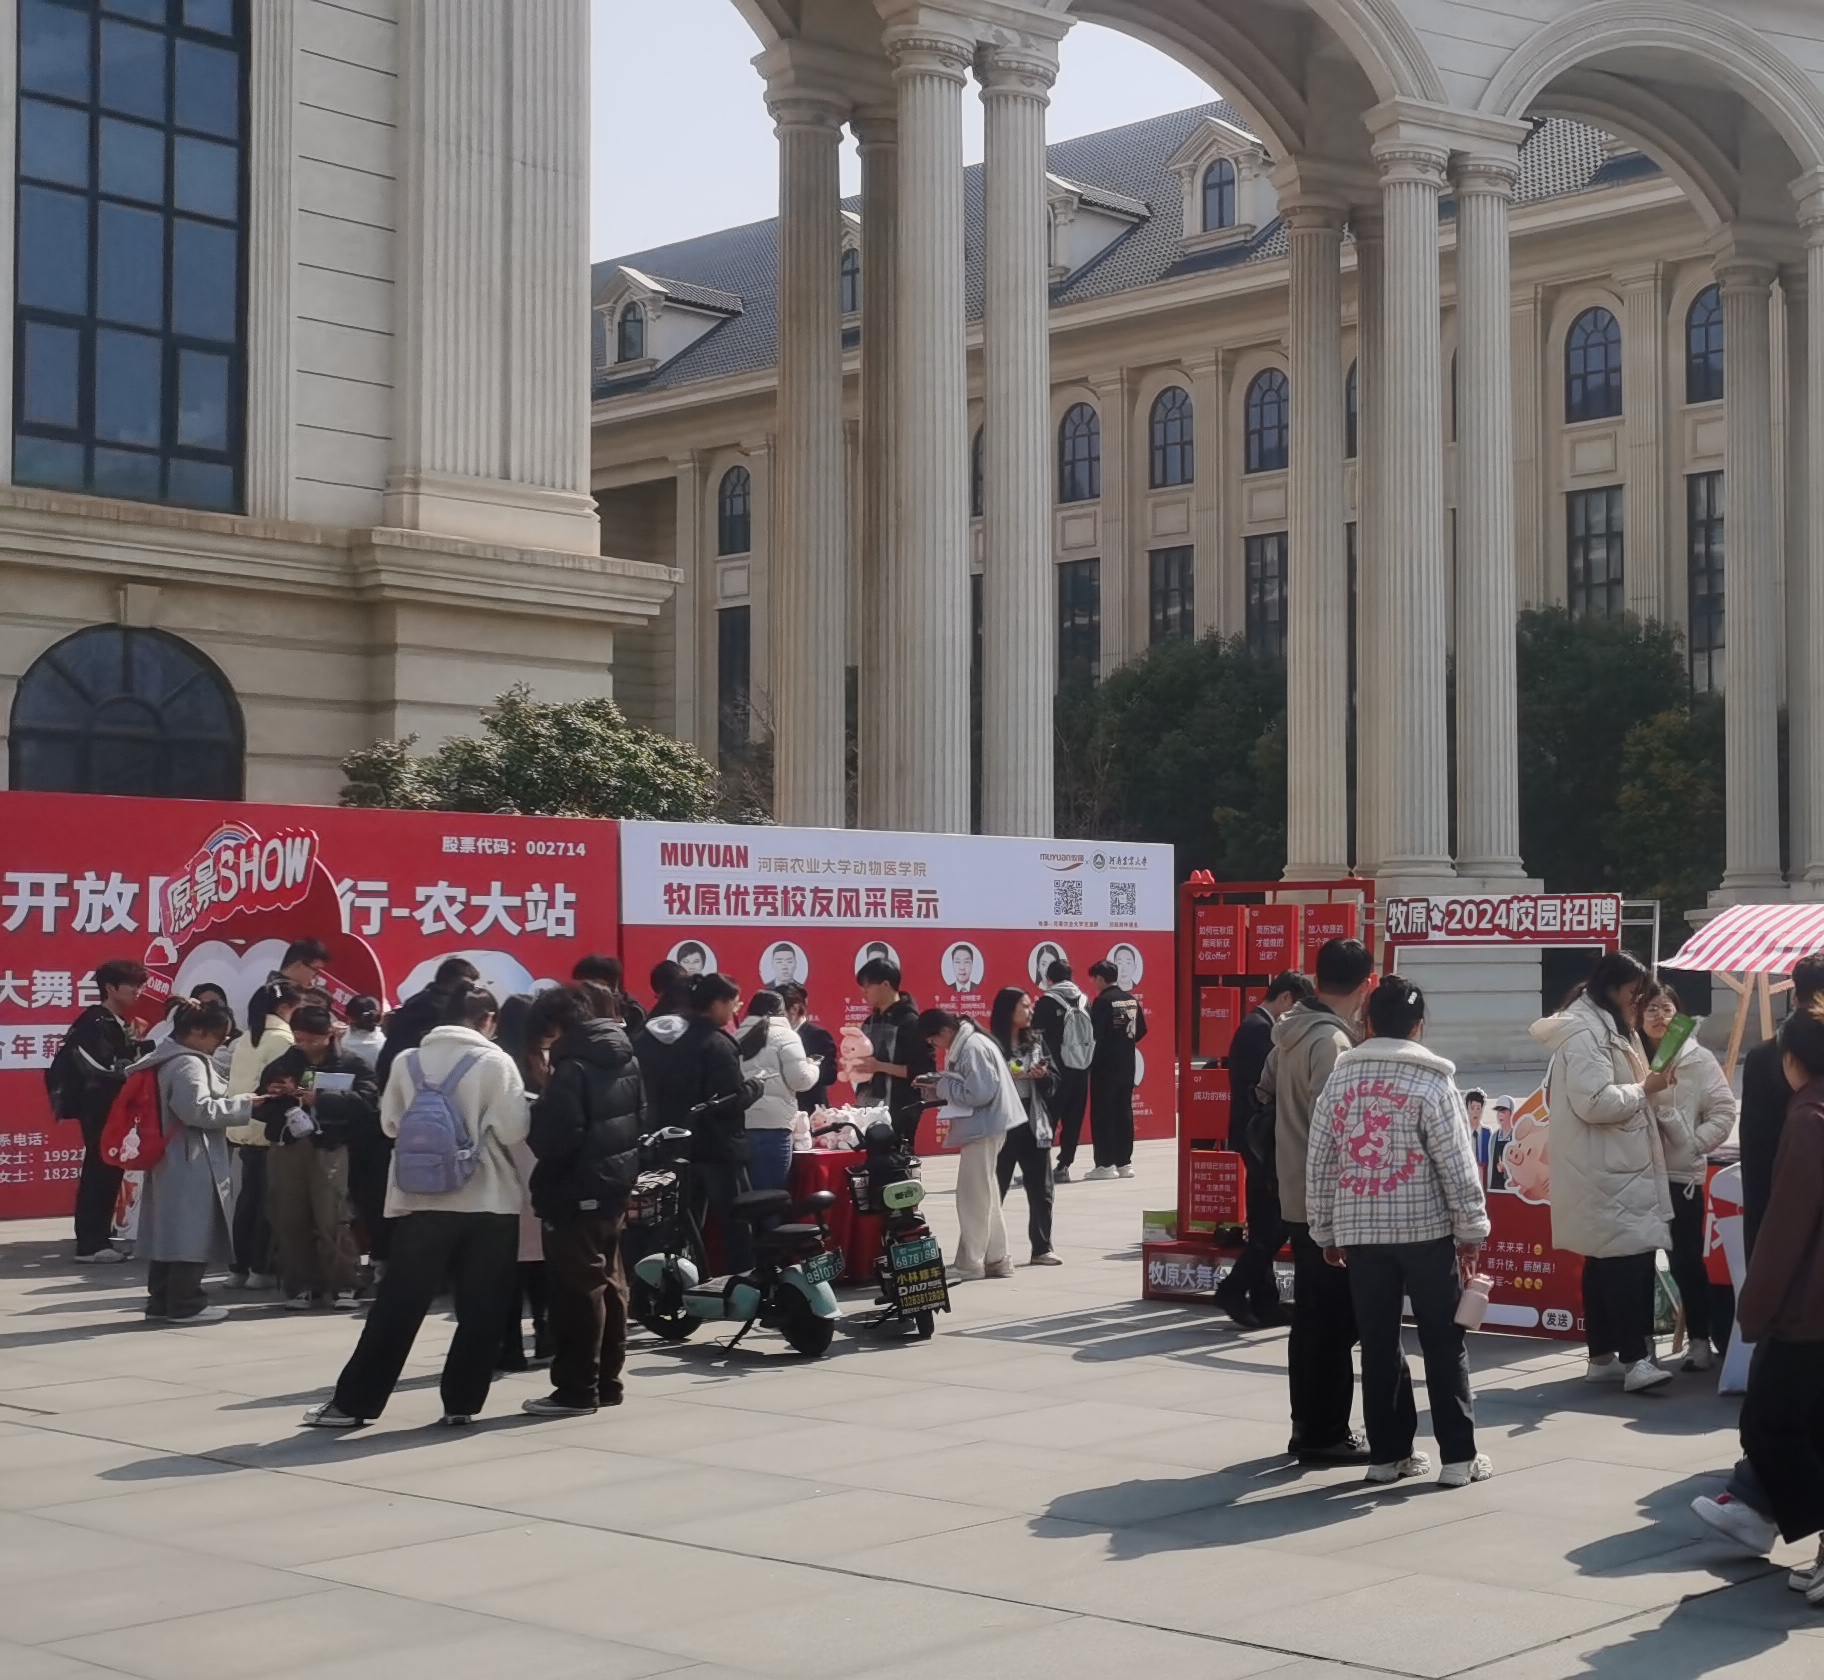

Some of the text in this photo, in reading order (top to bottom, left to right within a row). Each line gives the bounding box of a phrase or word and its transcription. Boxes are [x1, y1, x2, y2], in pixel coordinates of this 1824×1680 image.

[660, 842, 749, 869] MUYUAN
[757, 857, 927, 877] 河南农业大学动物医学院
[337, 877, 577, 937] 行-农大站
[663, 882, 939, 919] 牧原优秀校友风采展示
[1388, 898, 1618, 934] 牧原 2024校园招聘
[1546, 1312, 1569, 1328] 发送
